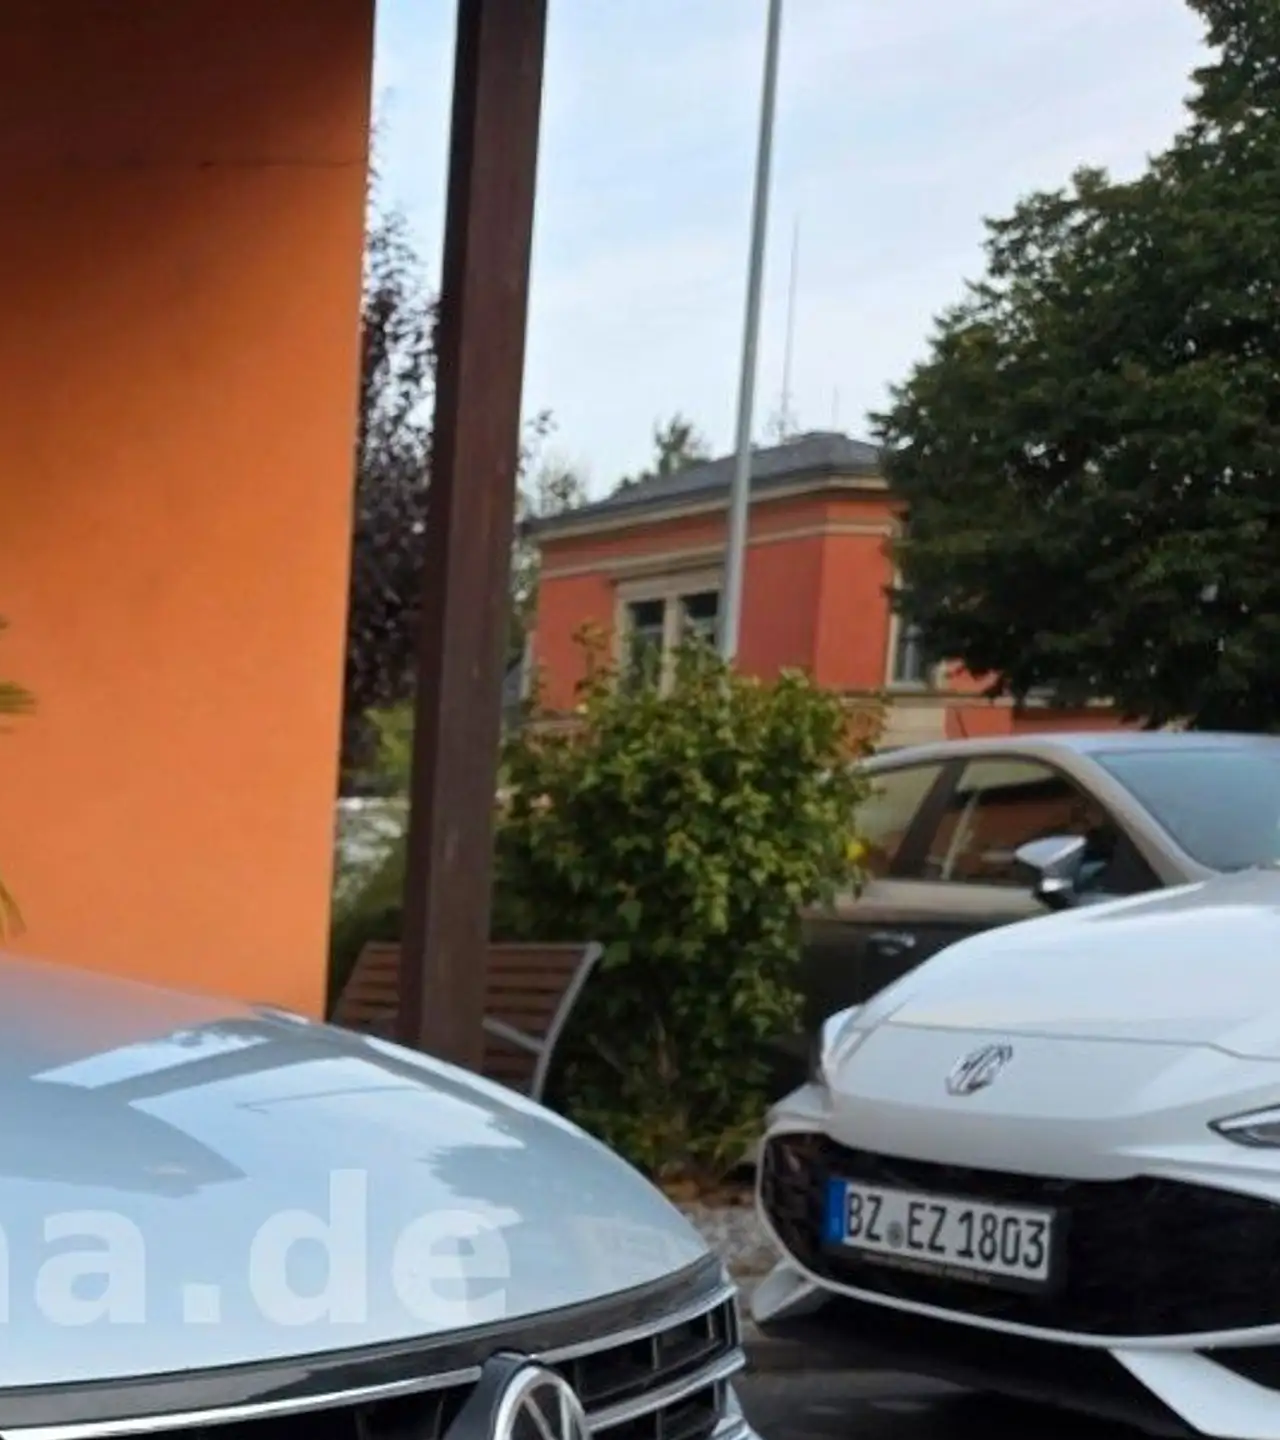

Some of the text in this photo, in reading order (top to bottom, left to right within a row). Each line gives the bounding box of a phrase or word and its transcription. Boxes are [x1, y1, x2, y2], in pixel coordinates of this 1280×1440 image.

[846, 1192, 882, 1242] BZ
[907, 1202, 947, 1253] EZ
[956, 1209, 1046, 1270] 1803
